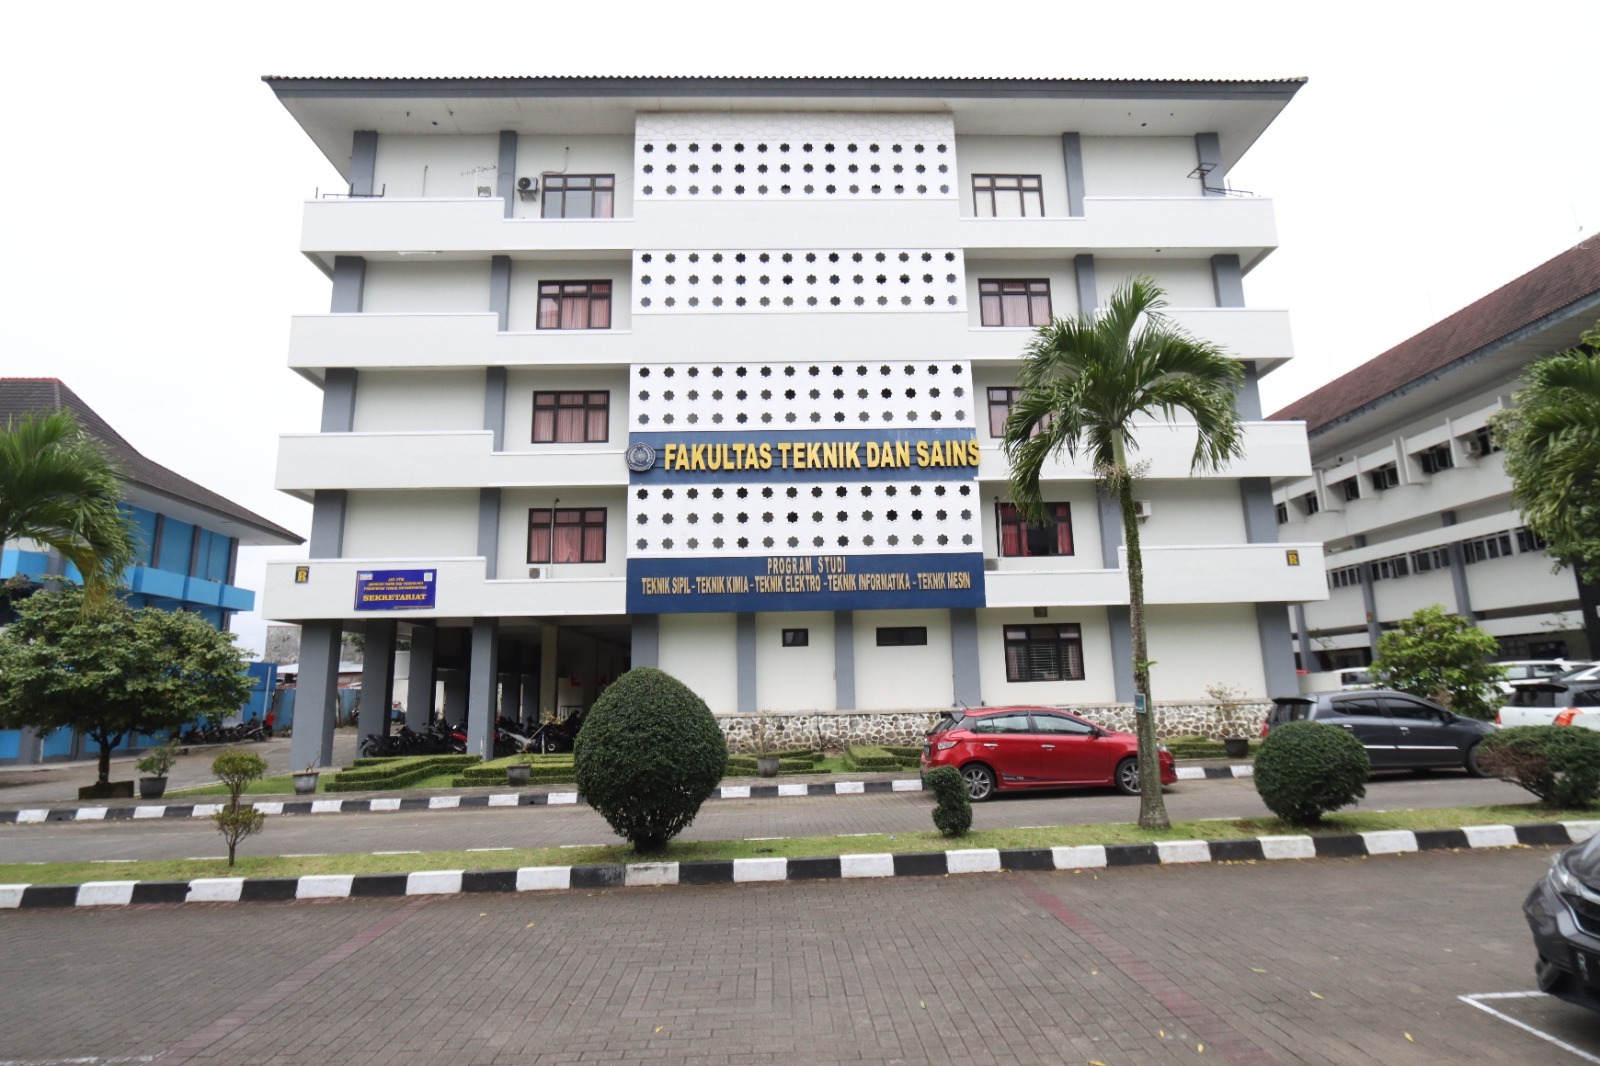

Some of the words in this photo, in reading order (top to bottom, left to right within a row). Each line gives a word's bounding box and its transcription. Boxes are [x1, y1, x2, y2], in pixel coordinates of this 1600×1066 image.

[664, 442, 773, 471] FAKULTAS
[778, 441, 861, 470] TEKNIK
[866, 440, 910, 468] DAN
[916, 439, 981, 468] SAINS
[767, 556, 812, 575] PROGRAM
[818, 556, 846, 574] STUDI
[641, 577, 671, 595] TEKNIK
[671, 576, 691, 594] SIPIL
[695, 576, 725, 594] TEKNIK
[726, 576, 749, 593] KIMIA
[755, 575, 784, 593] TEKNIK
[785, 574, 821, 592] ELEKTRO
[828, 574, 857, 592] TEKNIK
[858, 573, 911, 591] INFORMATIKA
[917, 572, 946, 590] TEKNIK
[947, 571, 971, 589] MESIN
[362, 593, 427, 602] SEKRETARIAT
